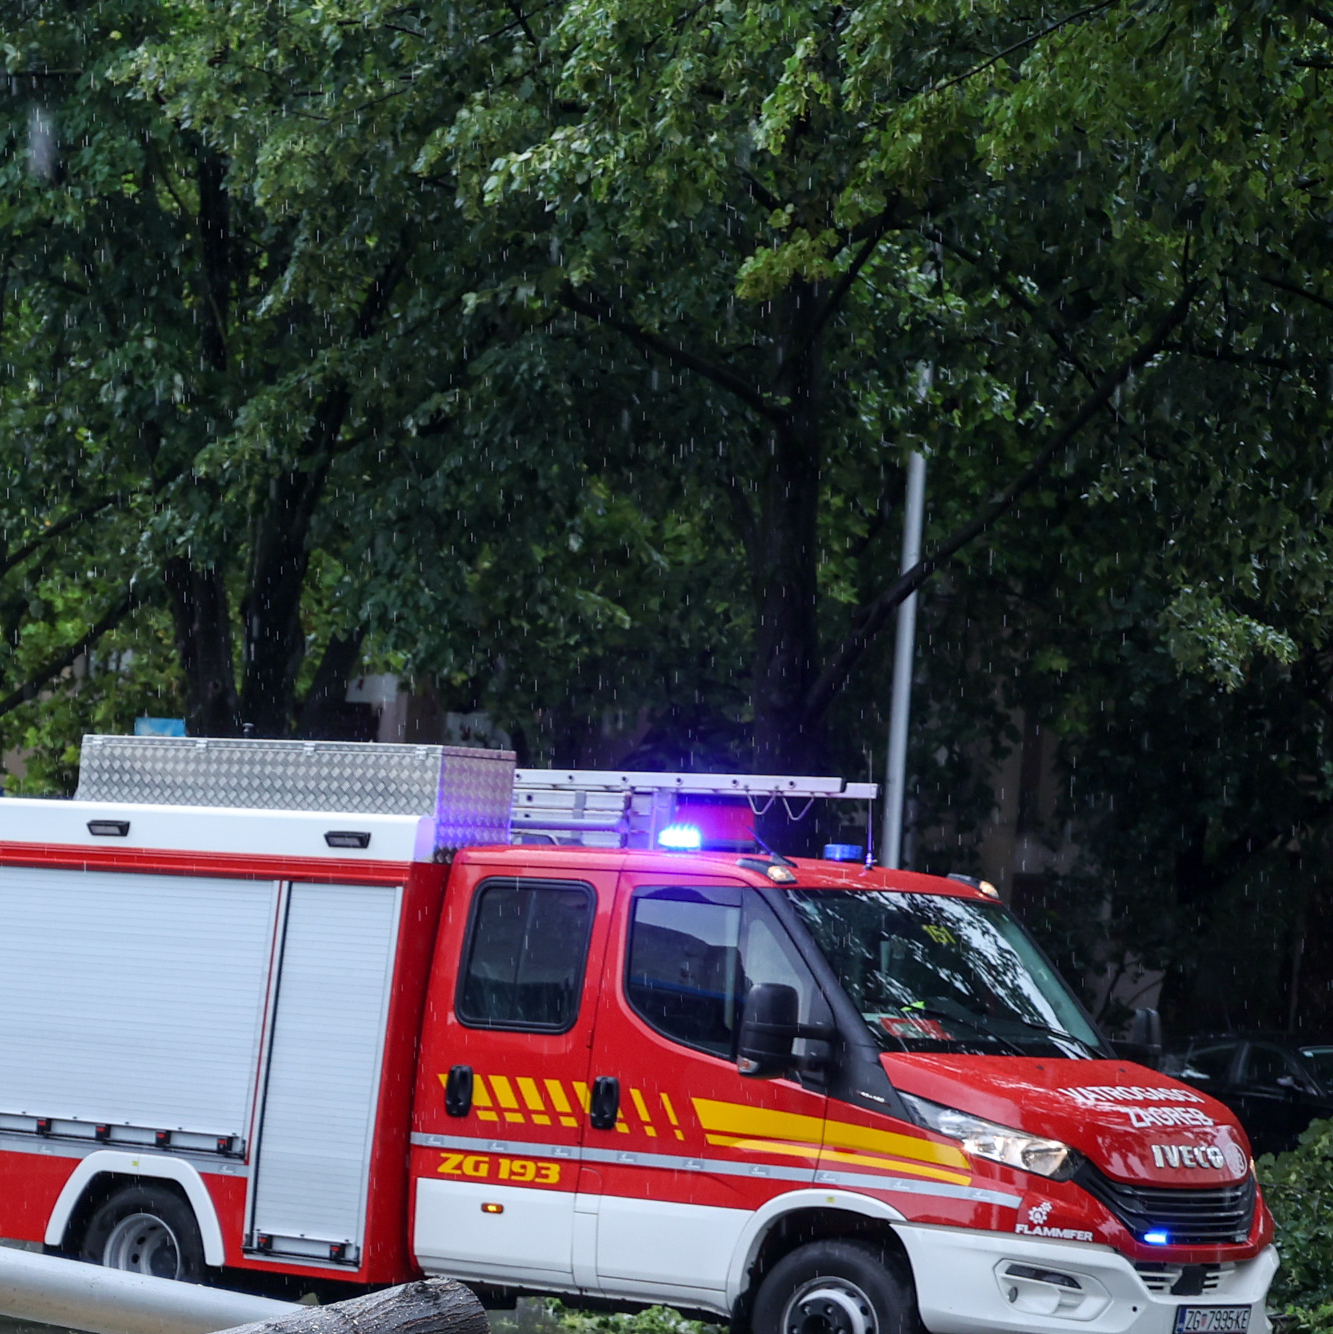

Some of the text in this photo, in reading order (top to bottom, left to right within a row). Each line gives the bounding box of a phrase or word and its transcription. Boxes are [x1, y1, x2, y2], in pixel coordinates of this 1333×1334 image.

[1057, 1086, 1206, 1104] VATROGASCI
[1121, 1106, 1215, 1128] ZAGREB
[1150, 1144, 1226, 1169] IVECO
[437, 1152, 561, 1184] ZG 193
[1015, 1223, 1094, 1242] FLAMMIFER
[1185, 1310, 1202, 1331] ZG
